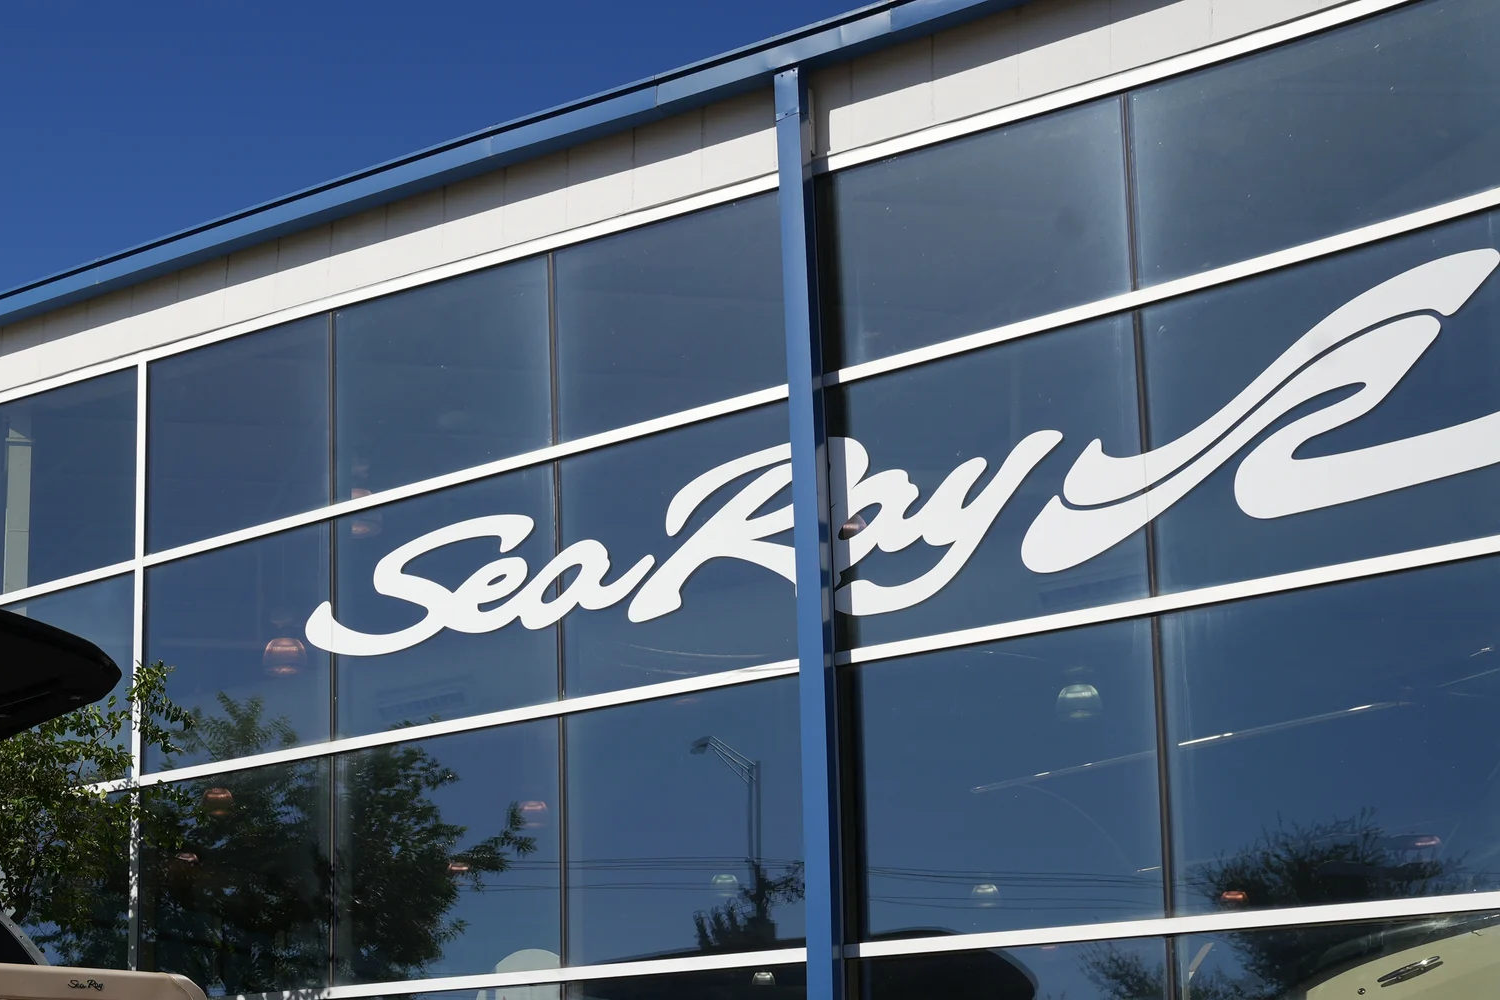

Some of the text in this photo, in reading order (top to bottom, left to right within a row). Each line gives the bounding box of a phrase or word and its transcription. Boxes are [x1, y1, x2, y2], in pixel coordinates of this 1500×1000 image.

[305, 429, 1063, 656] Sea Ray
[67, 979, 104, 991] Sea Ray
